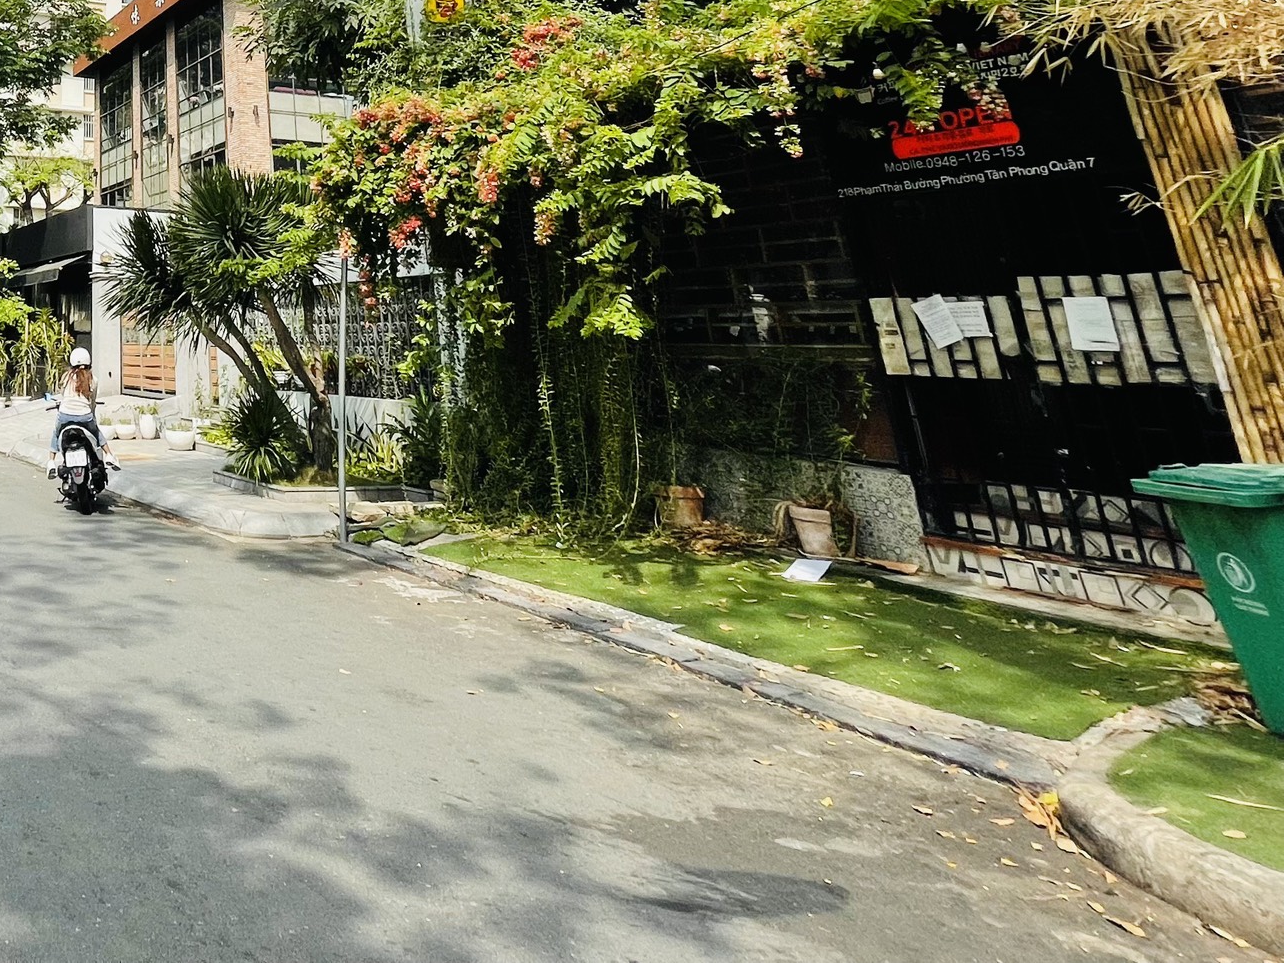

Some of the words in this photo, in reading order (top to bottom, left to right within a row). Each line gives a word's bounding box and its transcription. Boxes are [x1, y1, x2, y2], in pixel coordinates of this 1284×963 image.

[997, 52, 1029, 66] NM
[1008, 165, 1049, 177] Phong
[1086, 157, 1095, 168] 7
